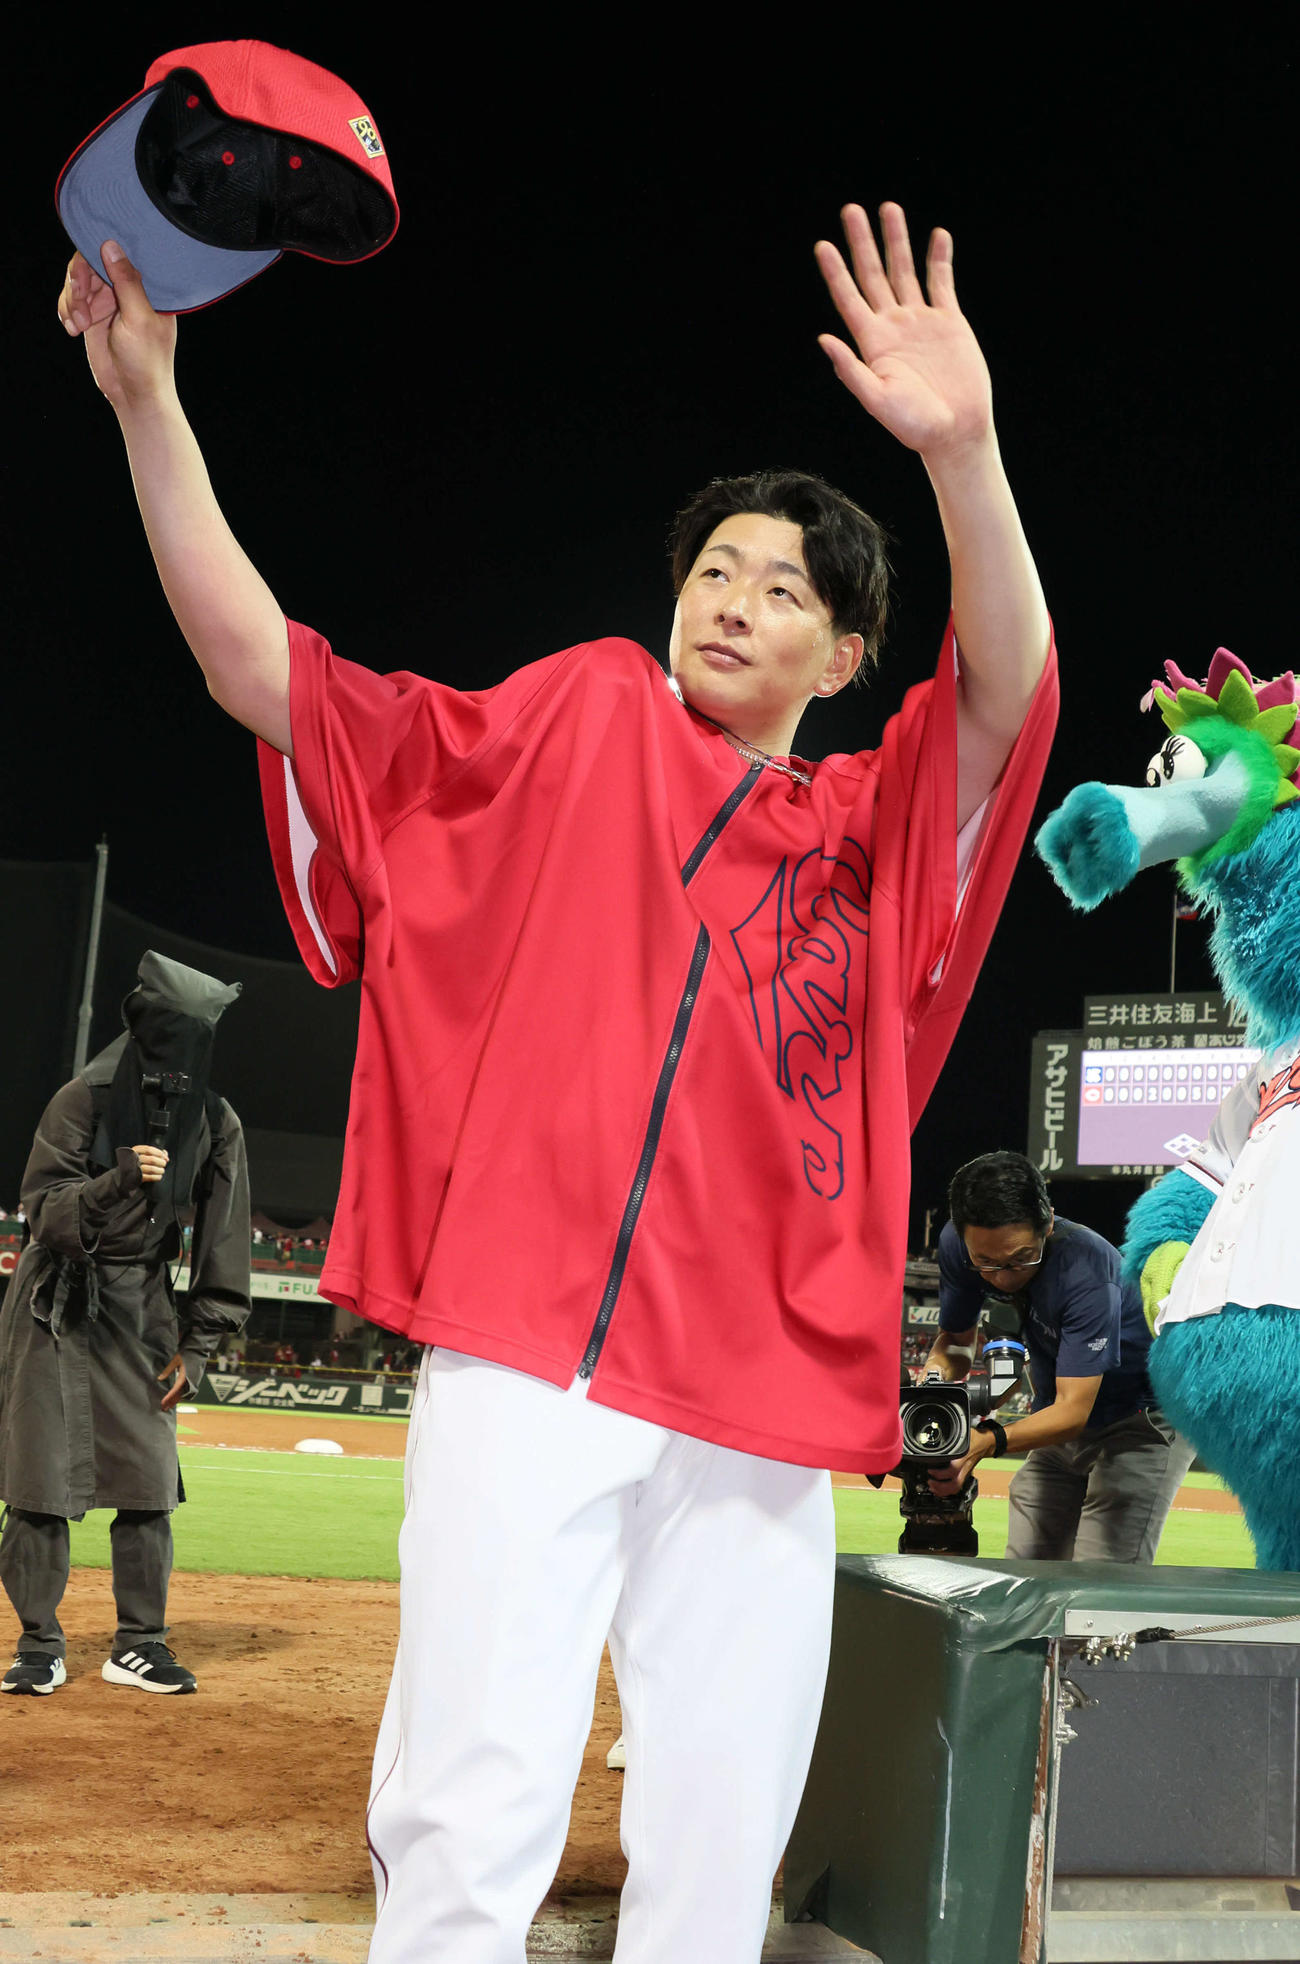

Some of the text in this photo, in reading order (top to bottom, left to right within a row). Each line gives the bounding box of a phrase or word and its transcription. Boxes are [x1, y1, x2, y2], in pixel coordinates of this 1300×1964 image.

[1088, 1002, 1217, 1025] 三井住友海上
[1040, 1044, 1069, 1171] アサヒビール
[293, 1283, 318, 1296] FU
[227, 1377, 349, 1406] ジーベック
